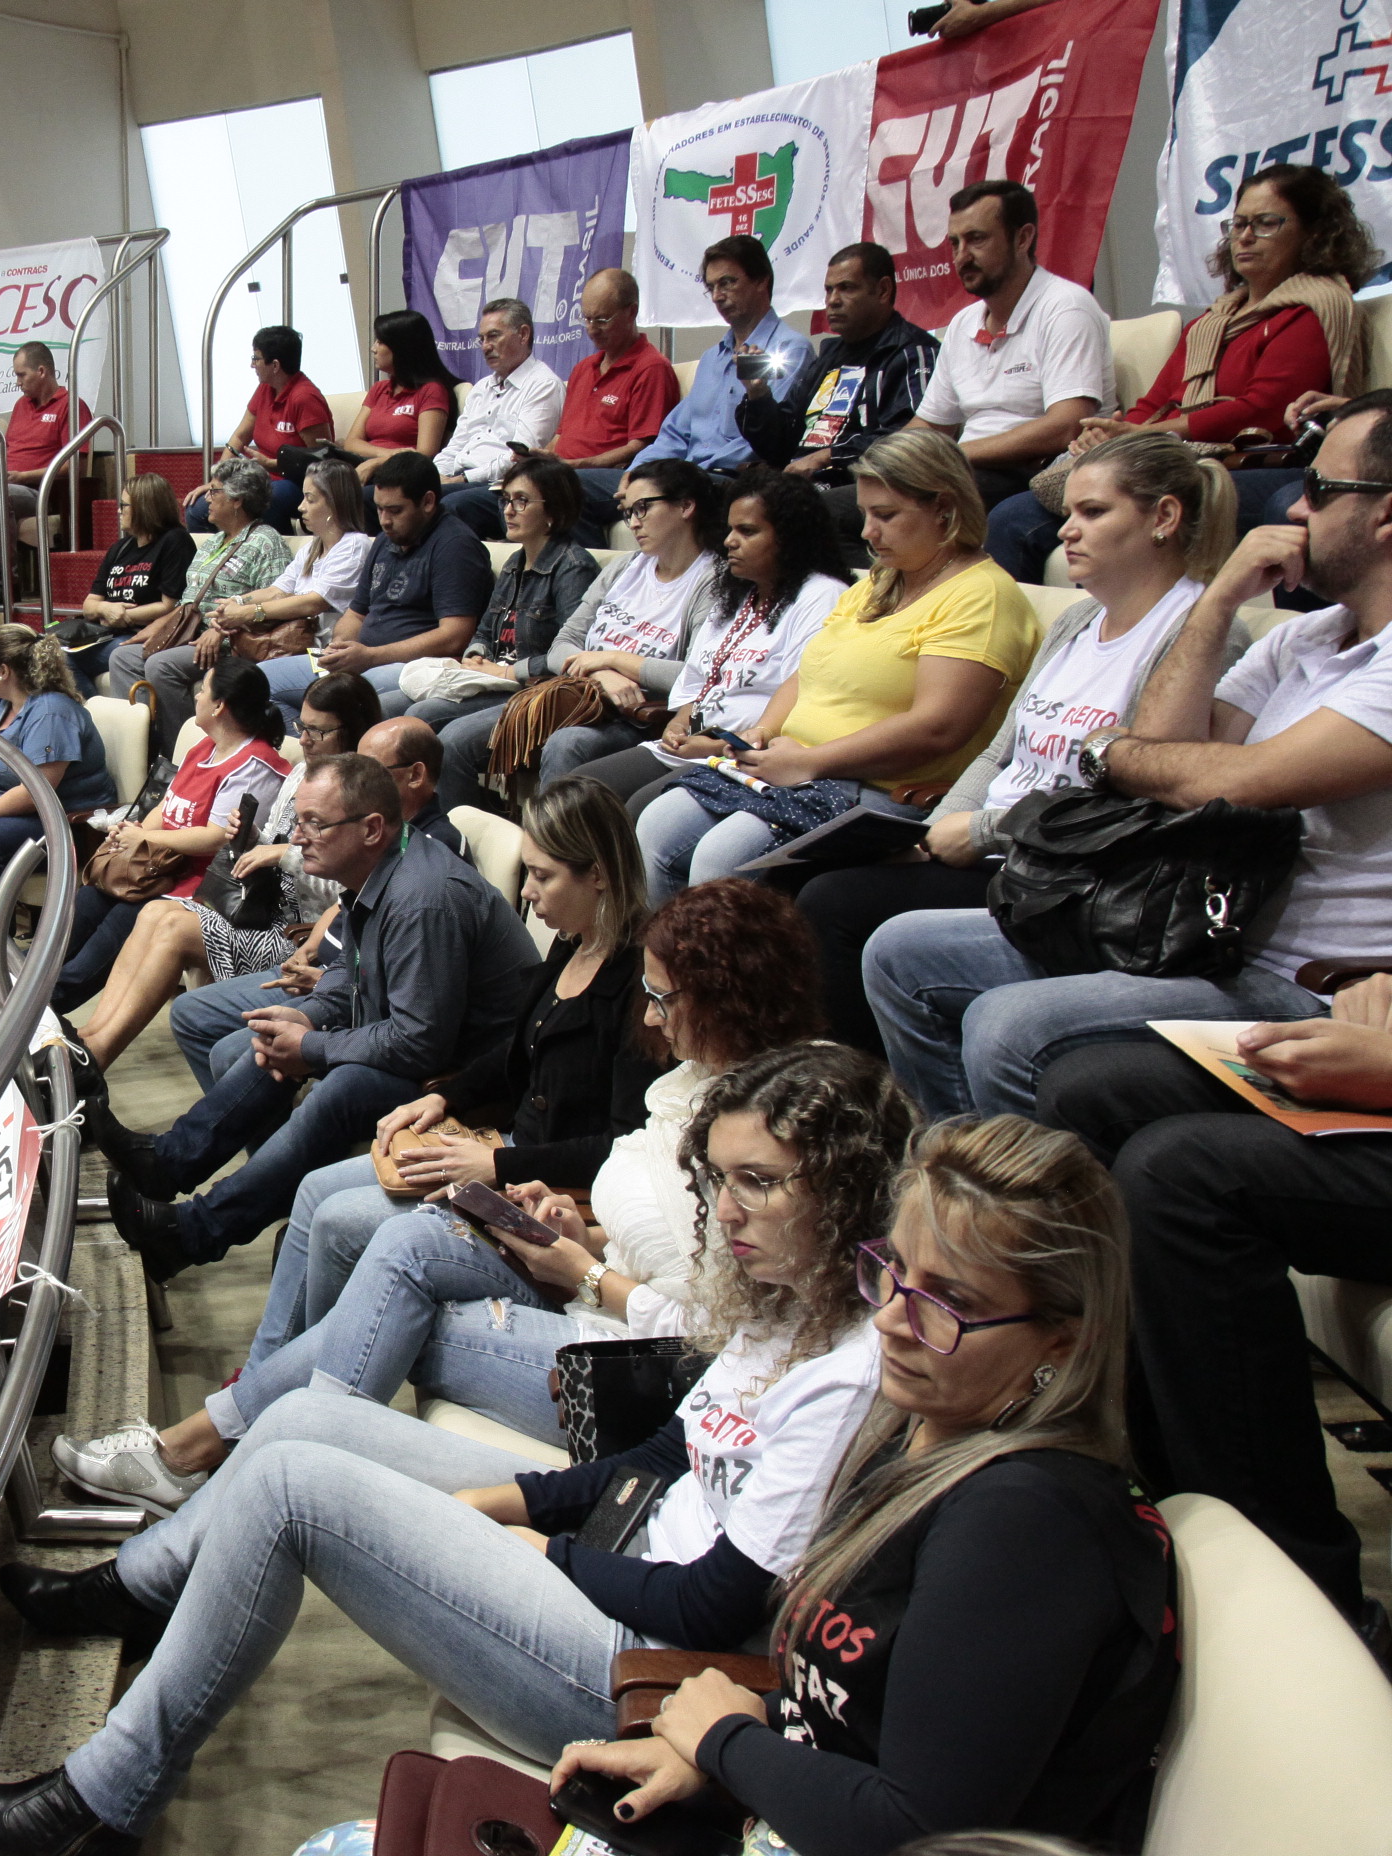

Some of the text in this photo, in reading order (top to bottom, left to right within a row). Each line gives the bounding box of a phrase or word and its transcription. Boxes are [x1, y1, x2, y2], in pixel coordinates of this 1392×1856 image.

[1022, 39, 1075, 191] RASIL
[871, 64, 1044, 256] CUT
[6, 265, 48, 277] CONTRACS
[434, 210, 580, 331] CUT
[131, 575, 150, 587] FAZ
[603, 629, 640, 654] LUTA
[736, 669, 758, 689] AZ
[1018, 724, 1028, 750] A
[1028, 730, 1067, 762] LUTA
[792, 1651, 849, 1727] FAZ
